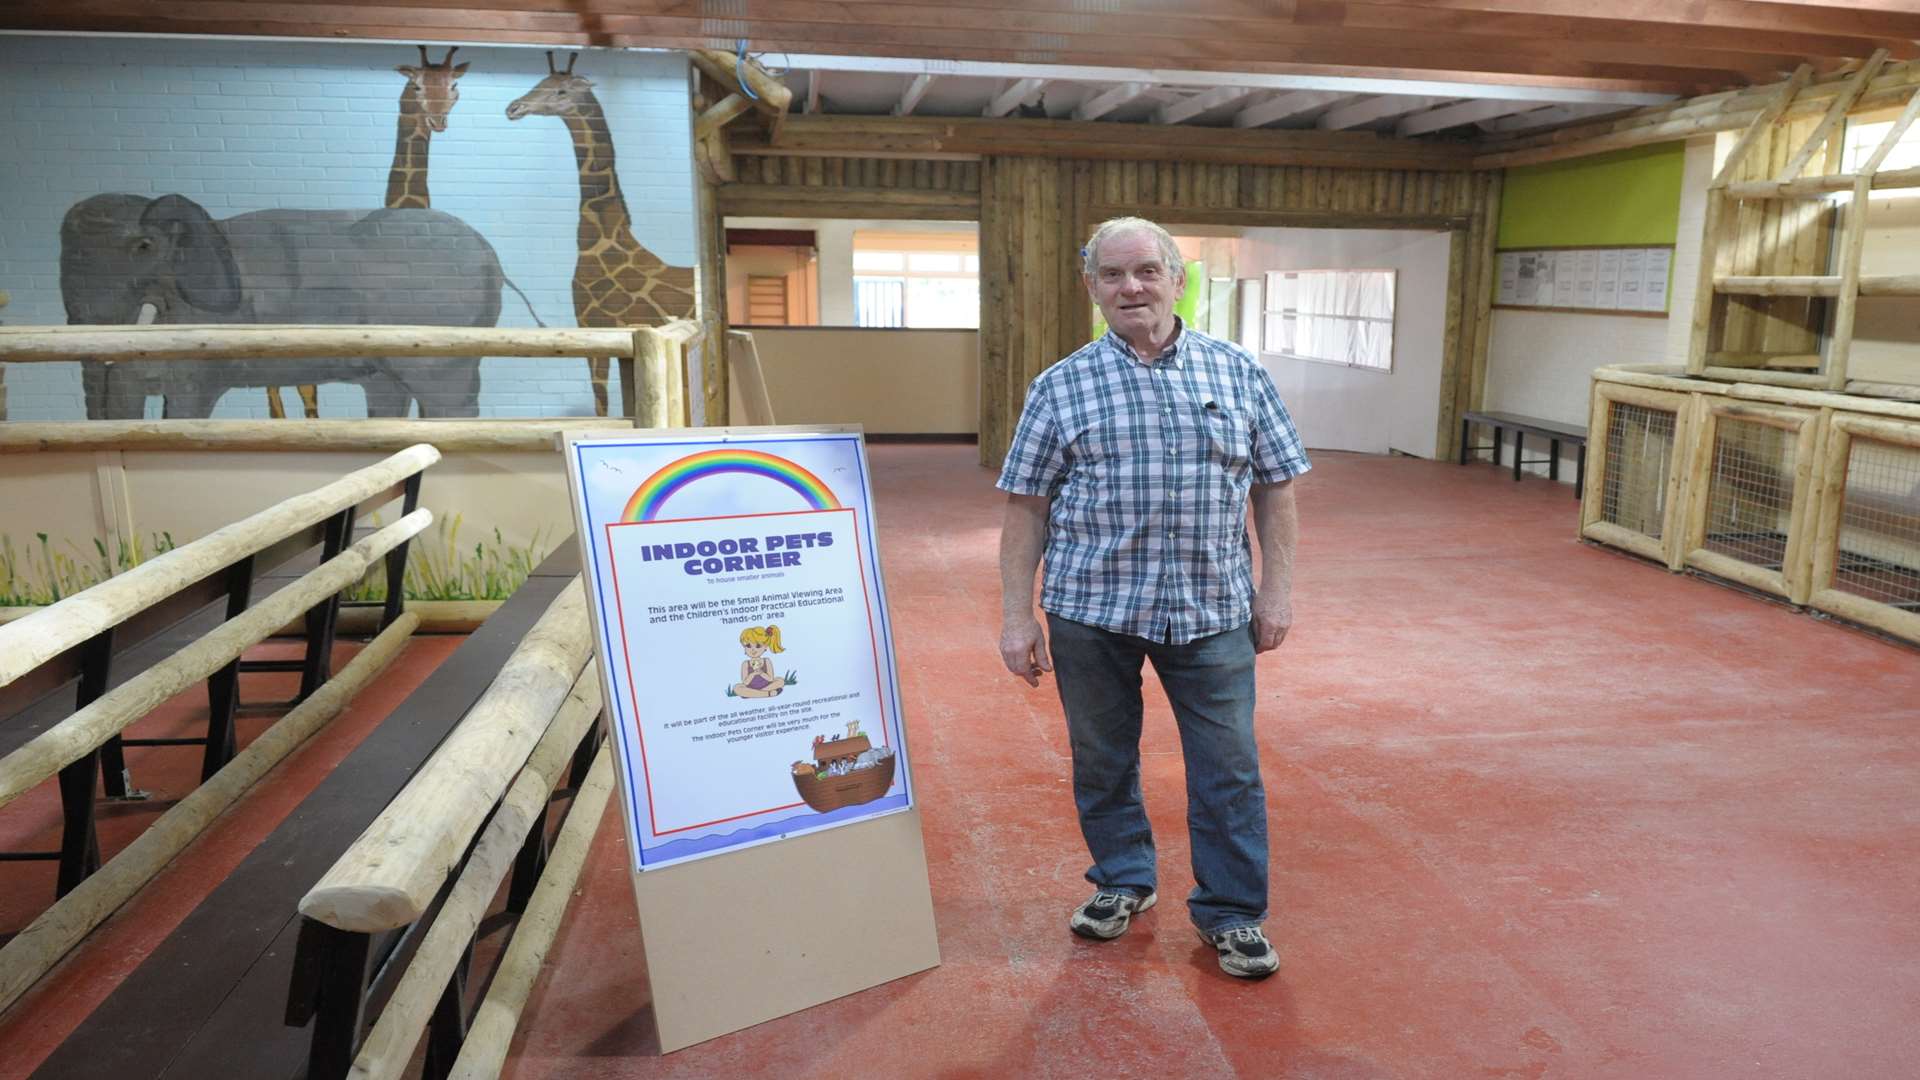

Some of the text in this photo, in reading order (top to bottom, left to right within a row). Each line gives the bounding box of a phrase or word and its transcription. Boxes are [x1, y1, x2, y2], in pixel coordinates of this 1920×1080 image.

[641, 532, 834, 561] INDOOR PETS
[684, 552, 802, 575] CORNER
[648, 587, 843, 614] This area will be the Small Animal Viewing Area
[649, 595, 844, 624] and the Children's Indoor Practical Educational
[766, 611, 785, 619] area
[693, 717, 708, 725] part
[812, 695, 847, 705] recreational
[718, 716, 756, 727] educational
[757, 711, 778, 721] facility
[727, 736, 753, 744] younger
[755, 730, 774, 739] visitor
[743, 725, 764, 733] Corner
[787, 719, 801, 727] very
